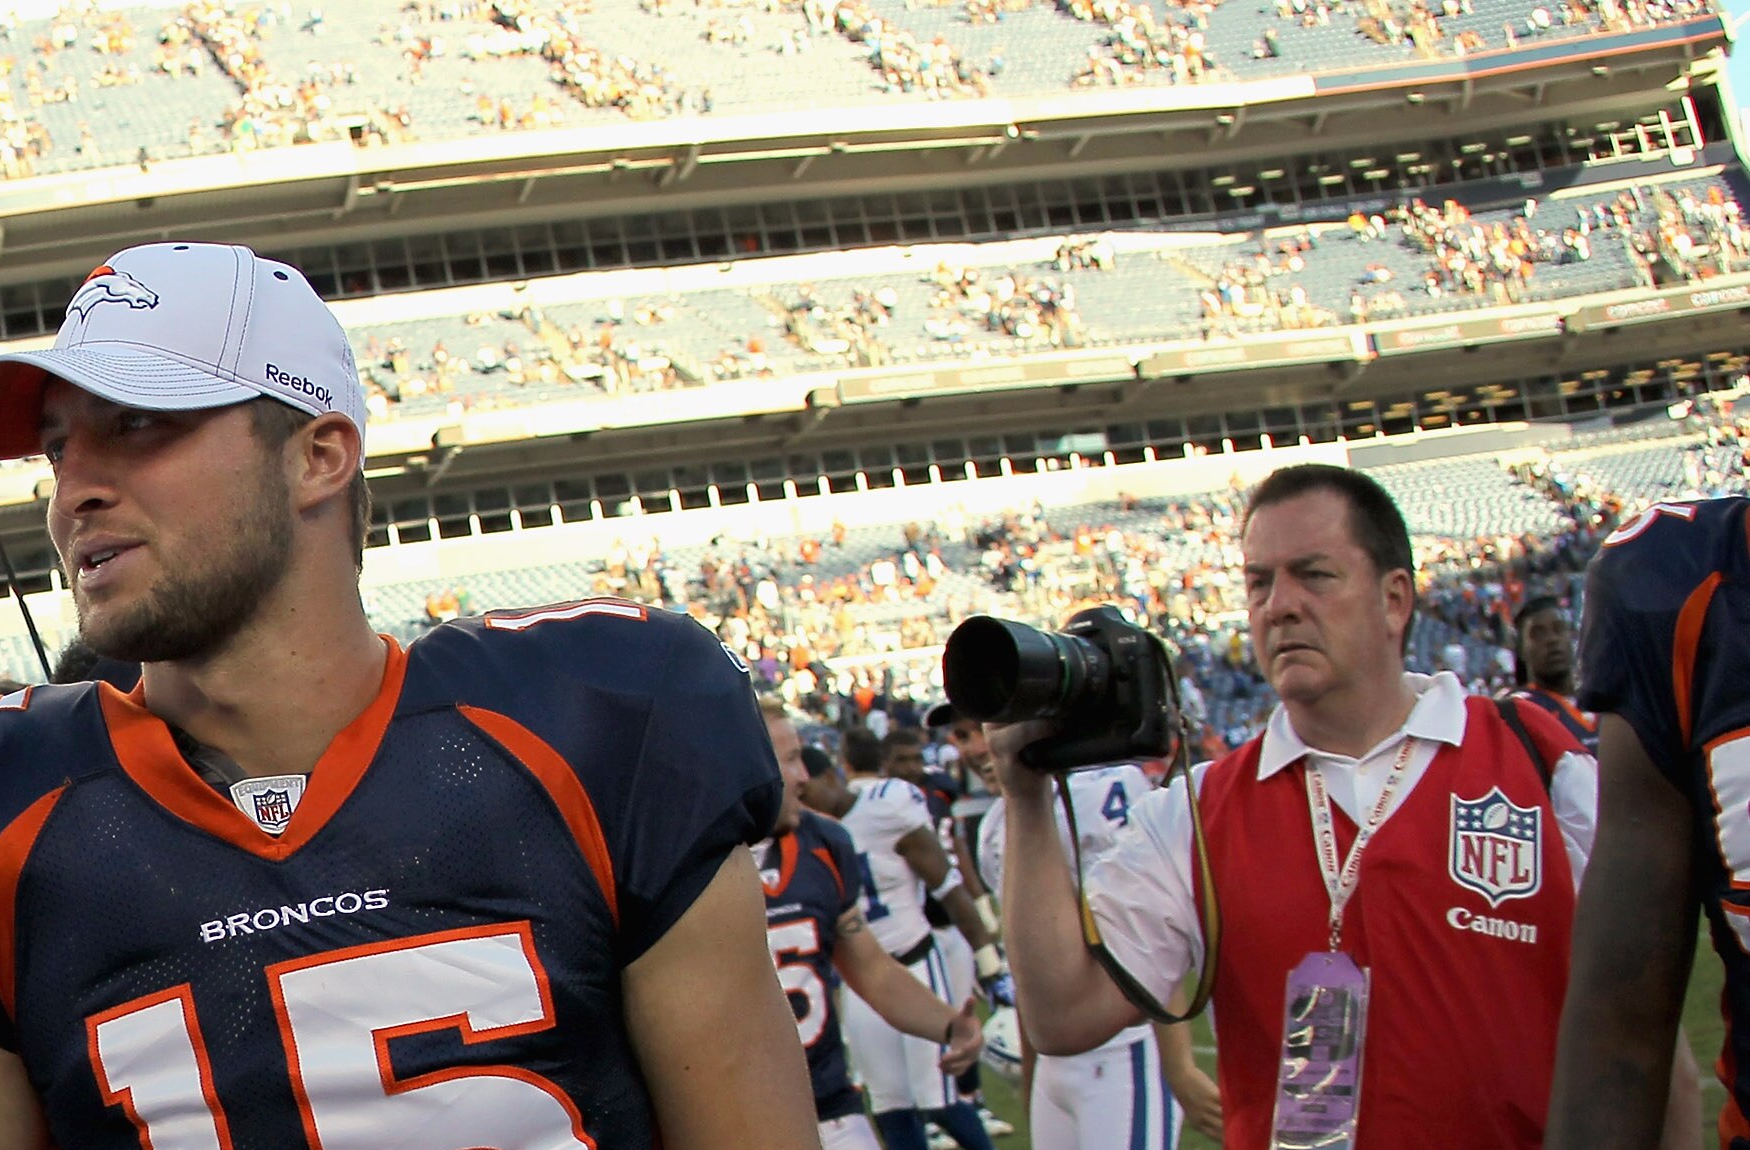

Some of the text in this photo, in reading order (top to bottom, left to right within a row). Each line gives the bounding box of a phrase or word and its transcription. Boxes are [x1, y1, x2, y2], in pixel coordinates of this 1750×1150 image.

[266, 363, 333, 410] Reebok
[259, 803, 289, 822] NFL
[1461, 834, 1530, 888] NFL
[201, 889, 389, 943] BRONCOS
[1446, 906, 1538, 944] Canon
